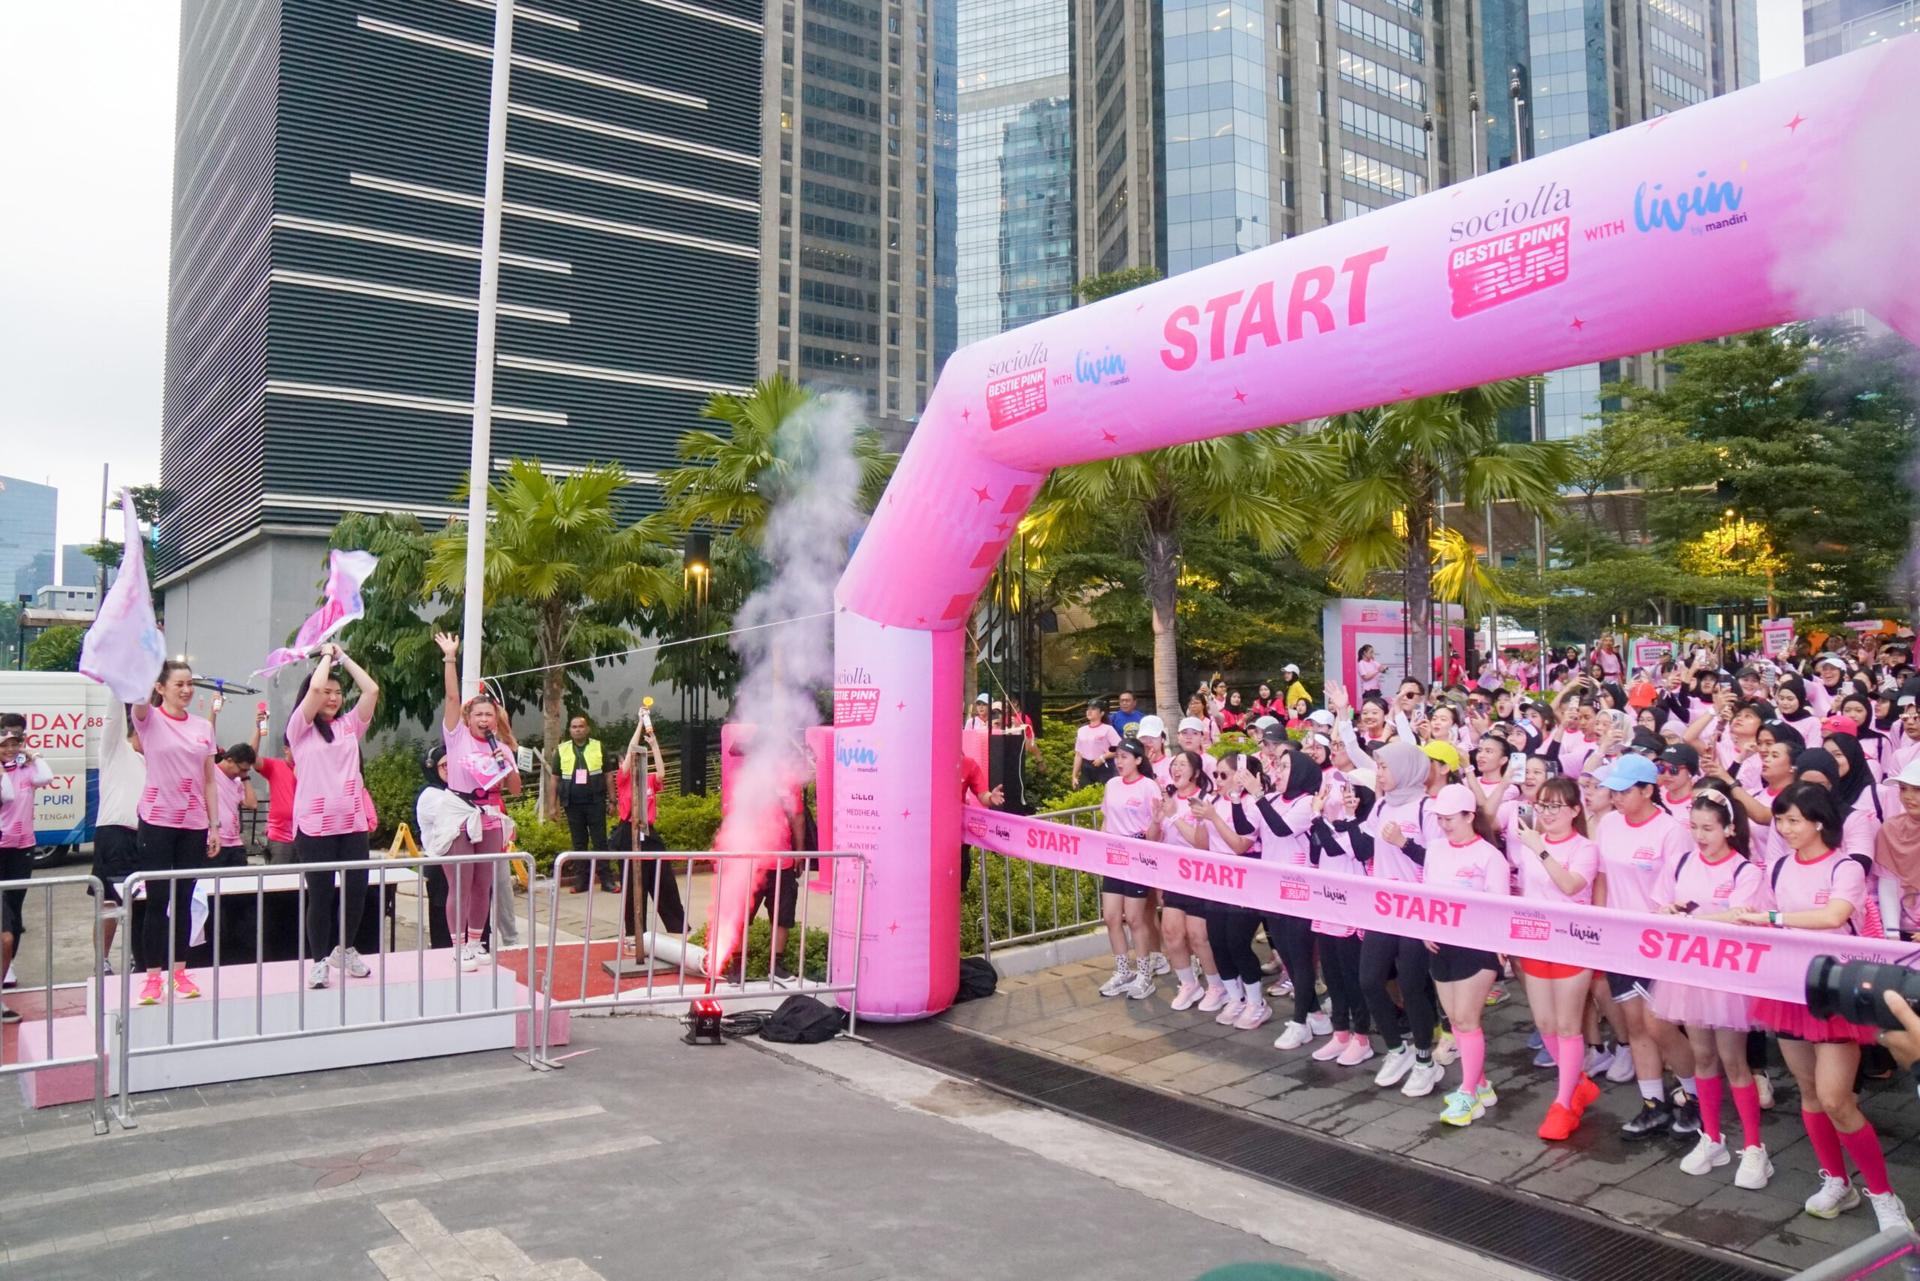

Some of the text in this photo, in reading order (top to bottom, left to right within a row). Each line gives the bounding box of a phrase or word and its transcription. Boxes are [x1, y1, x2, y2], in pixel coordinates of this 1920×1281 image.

[1450, 182, 1572, 243] sociolla
[1705, 212, 1748, 232] mandiri
[1584, 220, 1625, 241] WITH
[1453, 220, 1567, 270] BESTIE PINK
[1477, 241, 1566, 299] RUN
[1160, 246, 1389, 371] START
[987, 342, 1048, 378] sociolla
[988, 370, 1044, 398] BESTIE PINK
[1052, 374, 1072, 387] WITH
[851, 690, 879, 700] PINK
[24, 734, 84, 748] GENC
[35, 776, 75, 790] CY
[43, 795, 73, 806] PURI
[40, 813, 75, 821] TENGAH
[1026, 828, 1081, 855] START
[1178, 858, 1247, 889] START
[1374, 891, 1467, 927] START
[1639, 928, 1772, 974] START
